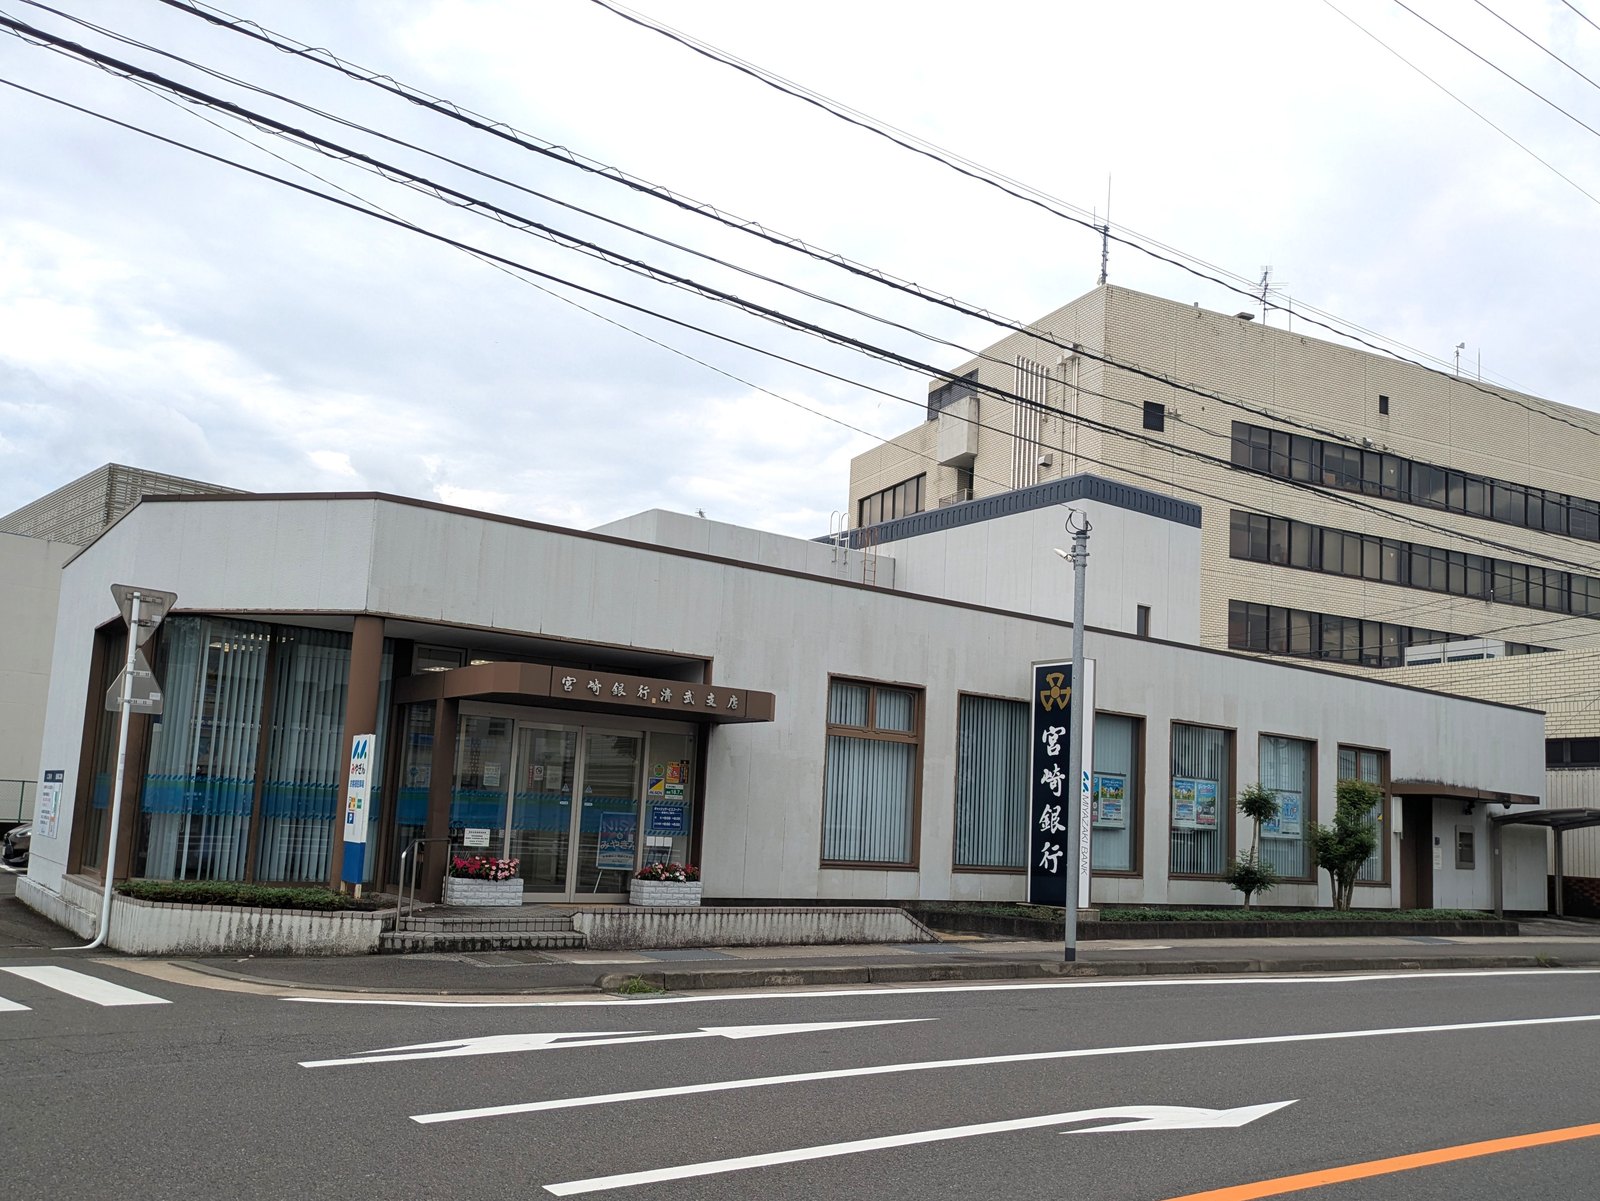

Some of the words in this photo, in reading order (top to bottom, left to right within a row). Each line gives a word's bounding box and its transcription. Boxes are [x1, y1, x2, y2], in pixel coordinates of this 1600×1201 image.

[561, 676, 738, 710] 宮崎銀行清武支店
[1039, 725, 1066, 874] 宮崎銀行
[1081, 794, 1089, 843] MIYAZAKI
